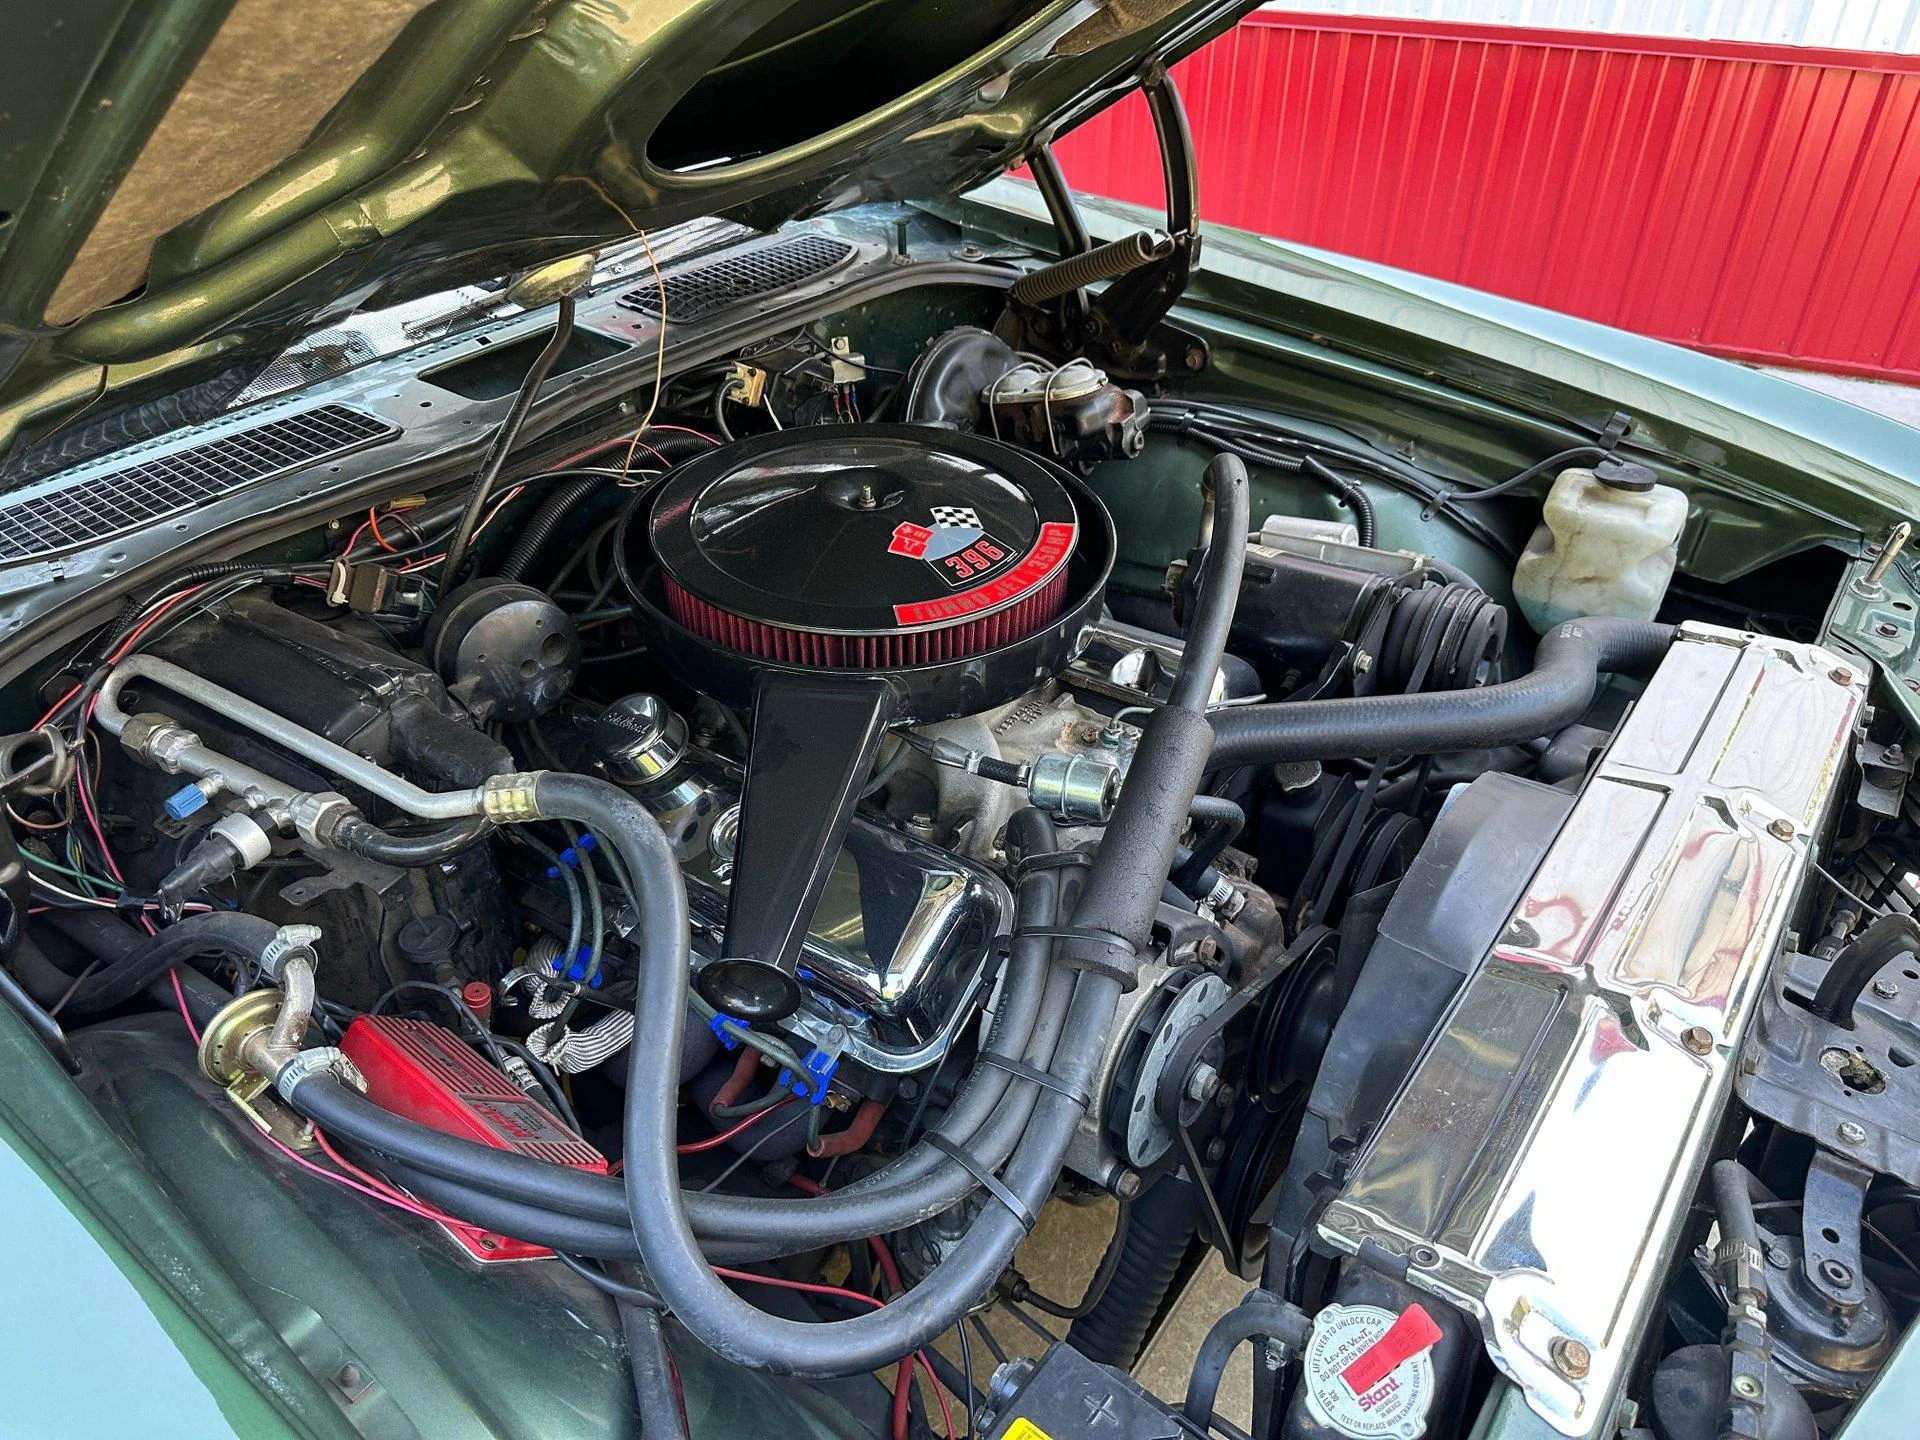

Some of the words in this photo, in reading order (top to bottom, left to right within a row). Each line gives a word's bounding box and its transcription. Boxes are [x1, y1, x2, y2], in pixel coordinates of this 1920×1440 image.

[944, 540, 1005, 579] 396
[913, 575, 1027, 621] TURBO-JET
[1027, 544, 1058, 571] 350
[986, 993, 1009, 1044] STANDARD
[1315, 1334, 1330, 1357] LEVER
[1326, 1326, 1337, 1336] TO
[1336, 1316, 1365, 1330] UNLOCK
[1366, 1316, 1382, 1327] CAP
[1319, 1370, 1330, 1382] DO
[1328, 1361, 1342, 1376] NOT
[1340, 1351, 1358, 1366] OPEN
[1356, 1338, 1375, 1354] WHEN
[1374, 1328, 1387, 1341] HOT
[1317, 1389, 1324, 1399] 16
[1328, 1389, 1340, 1402] 330
[1340, 1414, 1353, 1426] TEST
[1362, 1421, 1387, 1430] REPLACE
[1385, 1414, 1403, 1427] WHEN
[1400, 1388, 1419, 1417] CHANGING
[1411, 1361, 1421, 1390] COOLANT
[1358, 1376, 1400, 1413] Stant
[1375, 1393, 1399, 1414] ASSEMBLED
[1384, 1400, 1402, 1416] MEXICO
